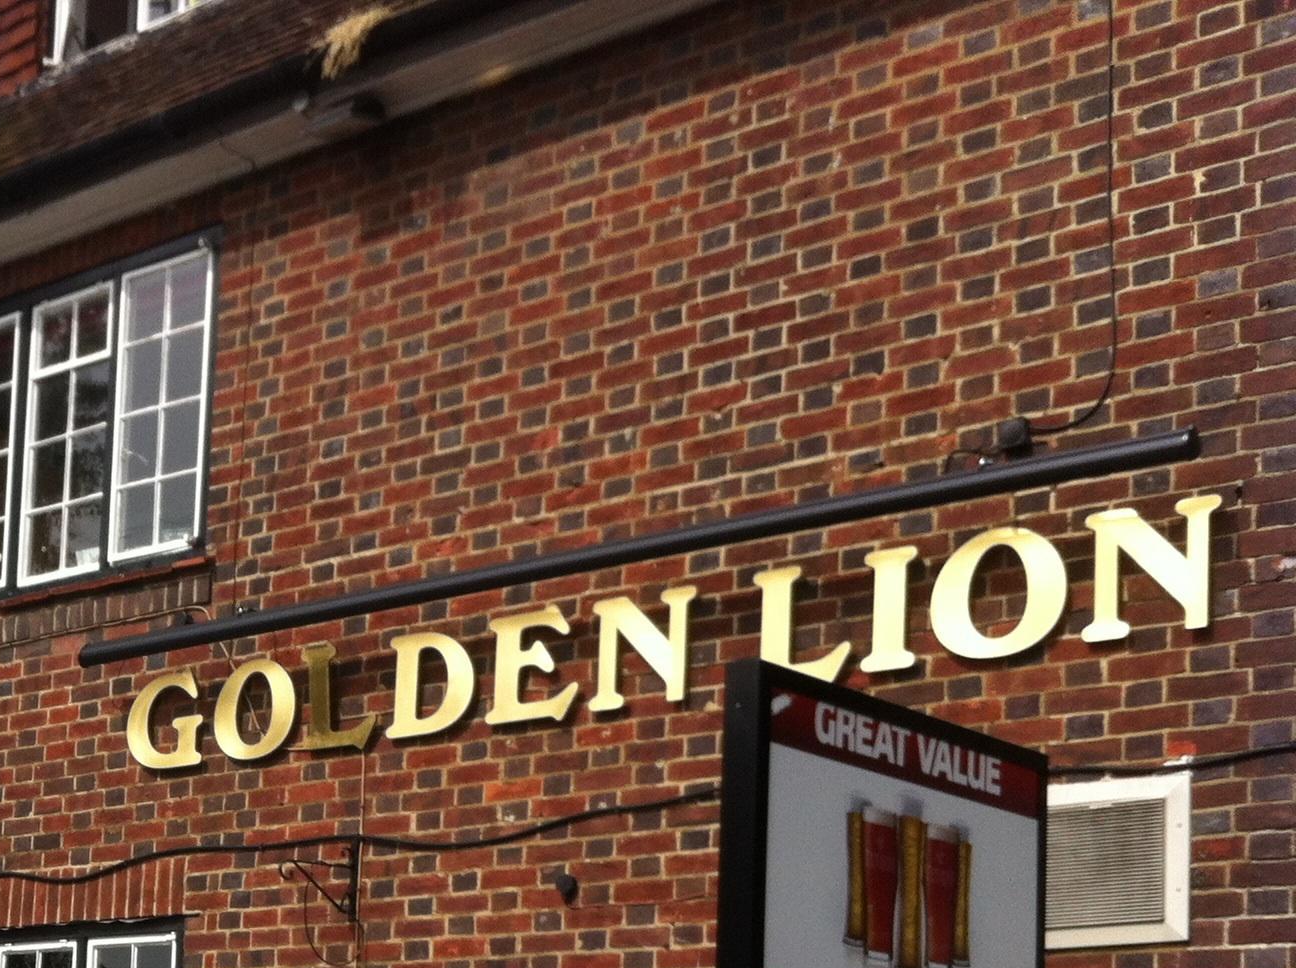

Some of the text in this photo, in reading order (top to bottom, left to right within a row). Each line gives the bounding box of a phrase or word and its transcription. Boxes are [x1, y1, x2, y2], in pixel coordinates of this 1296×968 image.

[127, 494, 1222, 768] GOLDEN LION
[814, 701, 1002, 796] GREAT VALUE
